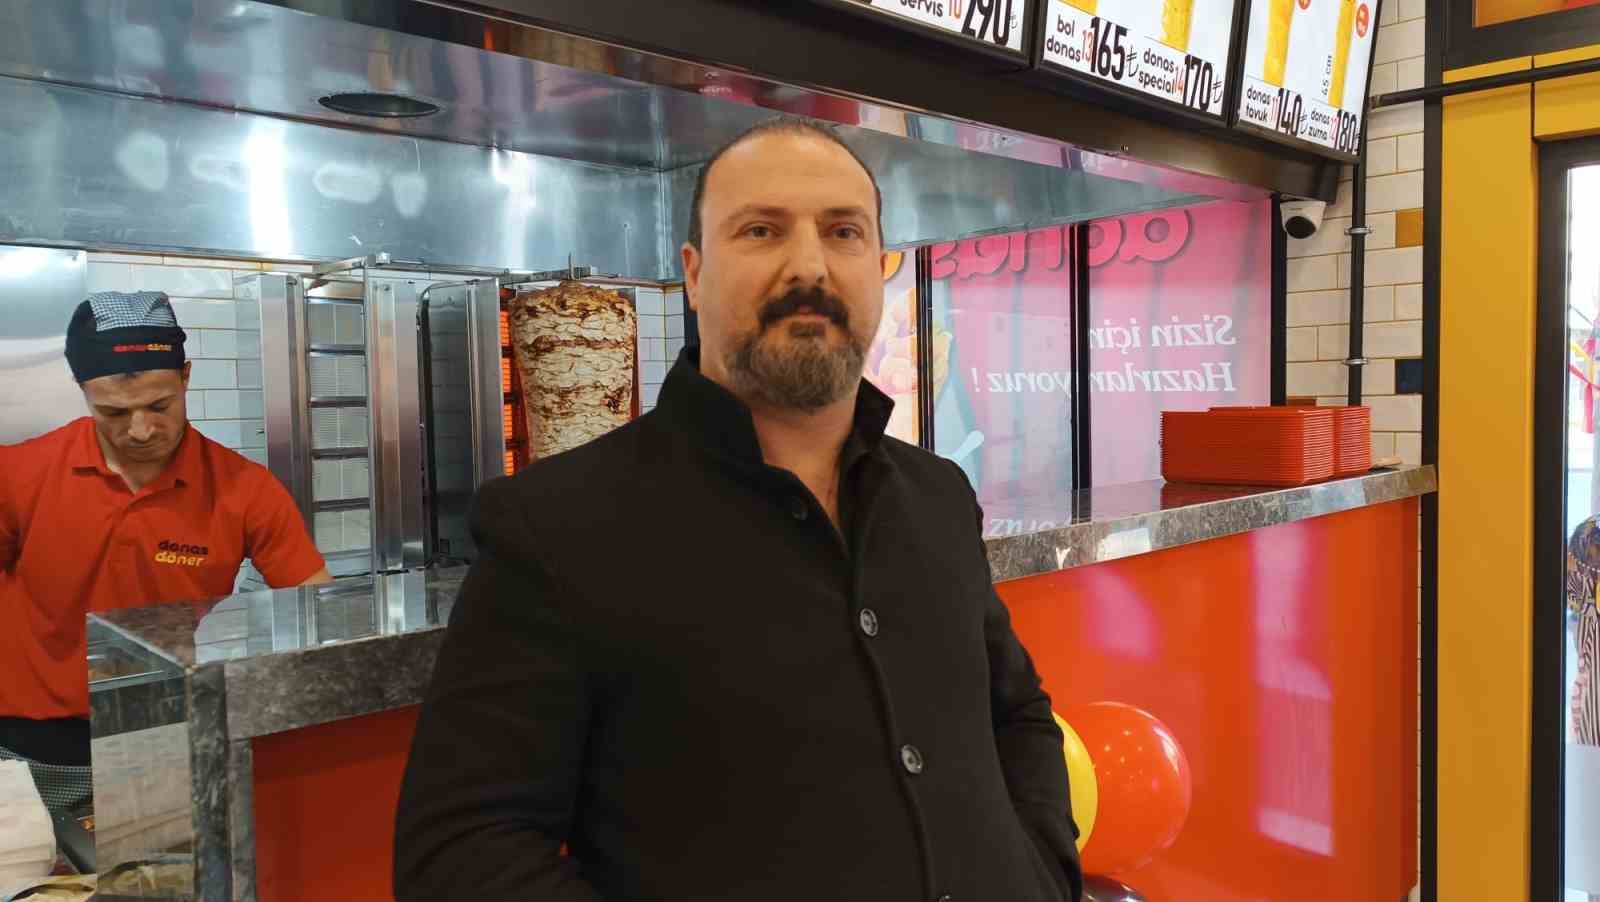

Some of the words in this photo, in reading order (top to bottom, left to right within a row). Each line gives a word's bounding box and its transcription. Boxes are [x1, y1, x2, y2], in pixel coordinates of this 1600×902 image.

[1057, 14, 1076, 38] bol
[1046, 35, 1082, 63] donas
[1082, 30, 1093, 65] 13
[1143, 47, 1175, 73] donas
[1138, 69, 1175, 96] special
[1246, 83, 1271, 106] donas
[1310, 108, 1331, 126] donas
